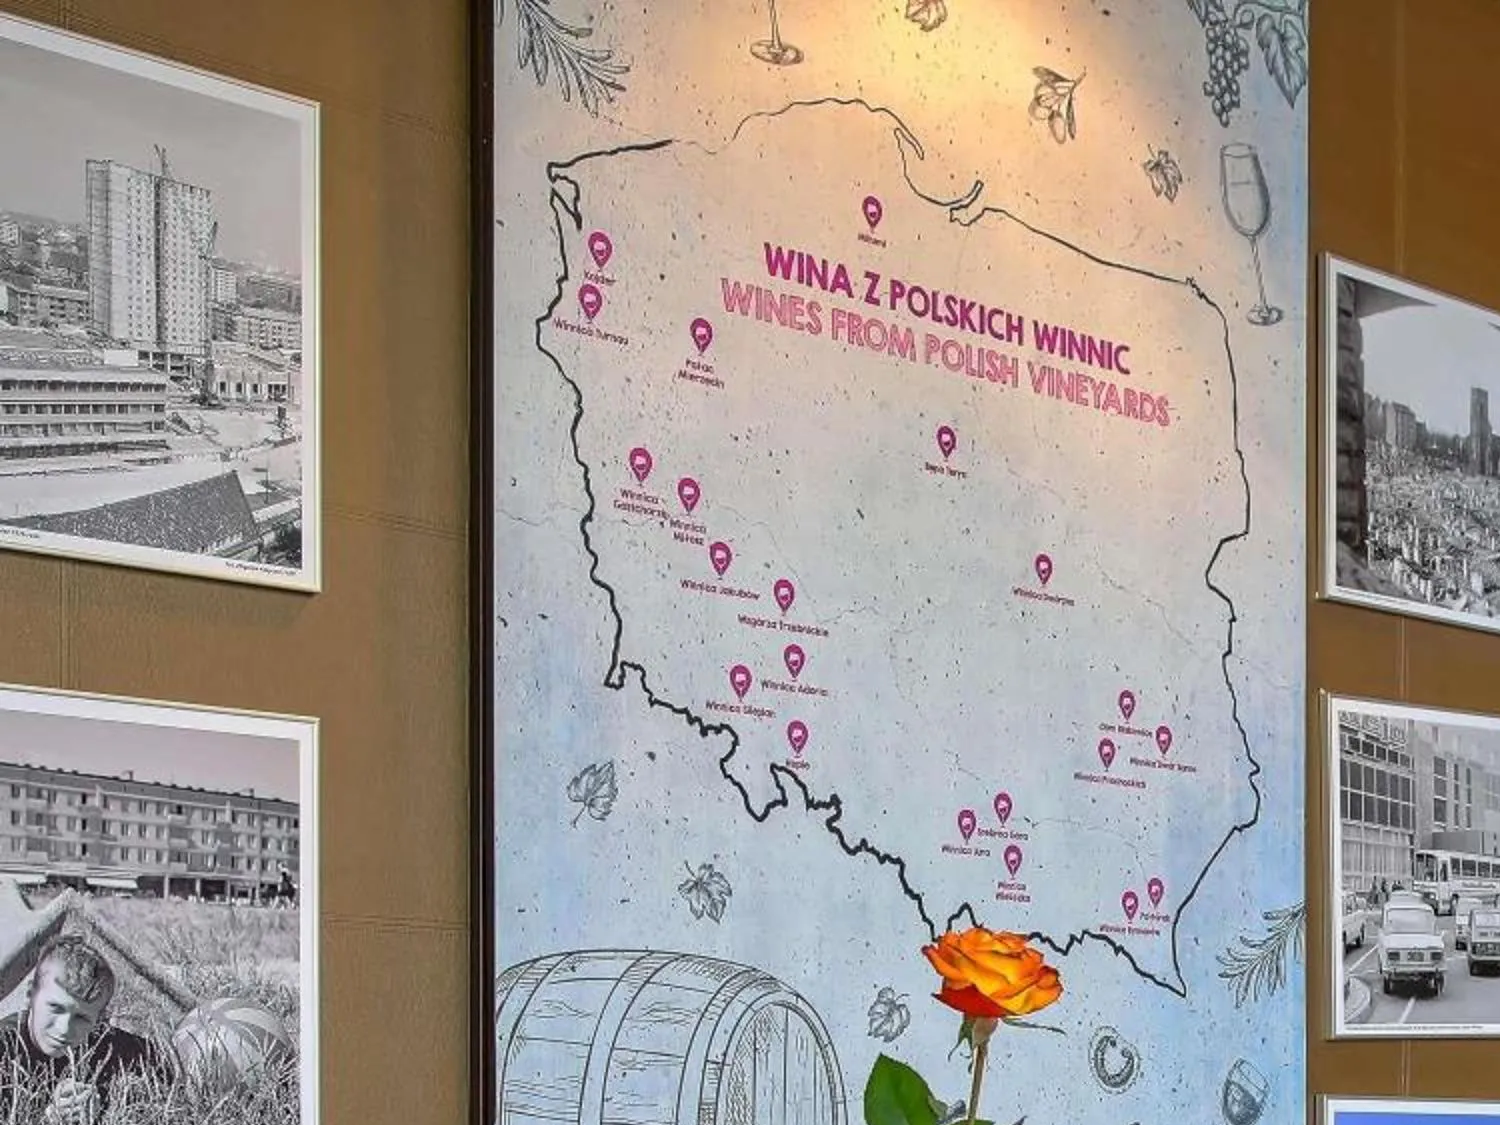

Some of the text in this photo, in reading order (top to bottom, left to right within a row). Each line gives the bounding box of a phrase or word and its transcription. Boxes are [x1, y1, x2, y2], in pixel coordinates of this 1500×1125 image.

[720, 277, 1170, 427] WINES FROM POLISH VINEYARDS
[764, 242, 1131, 375] WINA Z POLSKICH WINNIC
